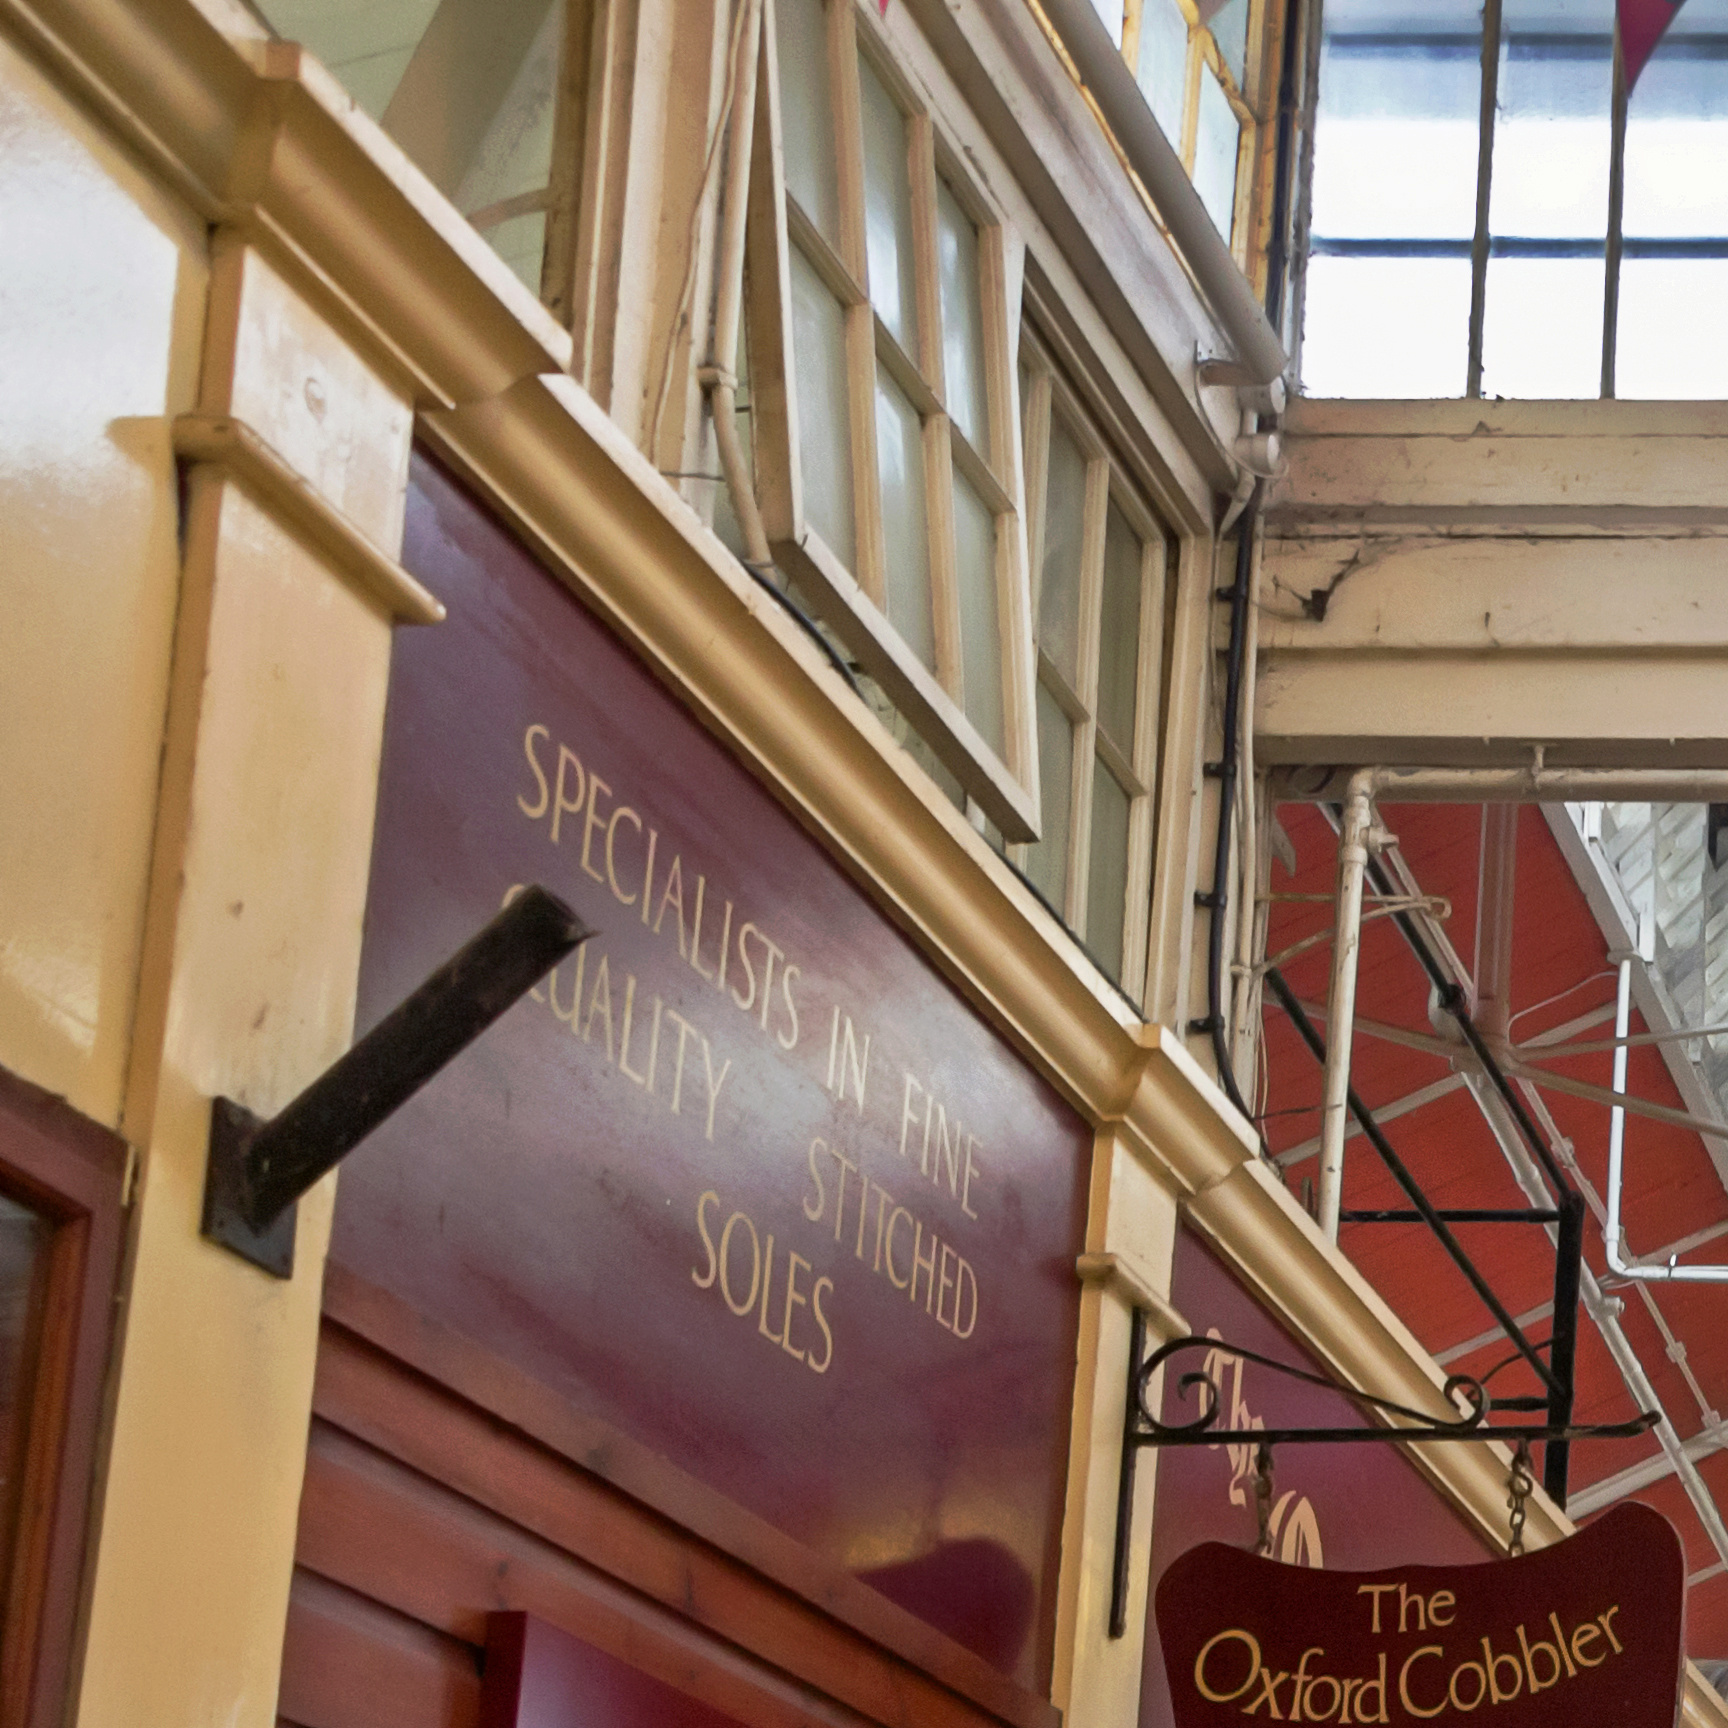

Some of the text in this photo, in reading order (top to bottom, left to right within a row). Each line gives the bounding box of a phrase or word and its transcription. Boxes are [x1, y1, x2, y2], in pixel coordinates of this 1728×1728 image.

[517, 723, 984, 1220] SPECIALISTS IN FINE
[501, 884, 979, 1340] UALITY STITCHED
[691, 1190, 835, 1374] SOLES
[1194, 1604, 1624, 1726] Oxford Cobbler
[1356, 1582, 1456, 1634] The
